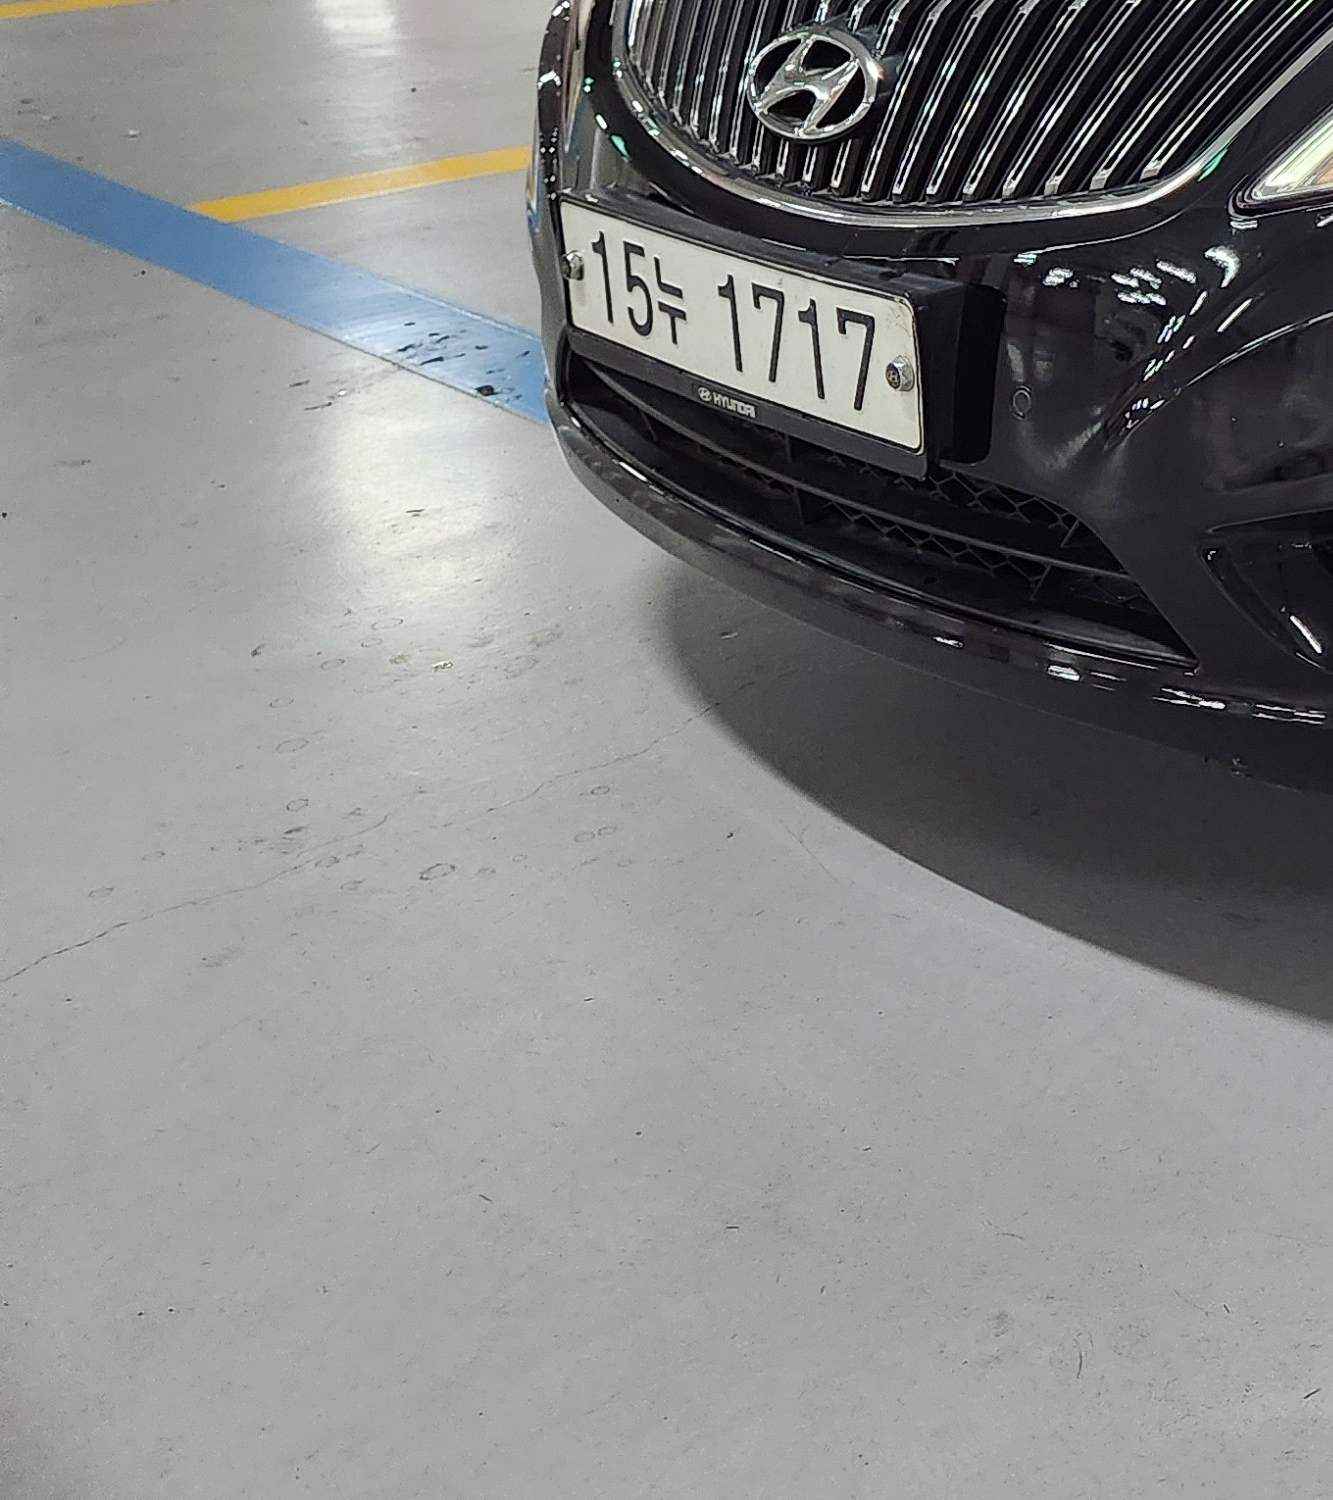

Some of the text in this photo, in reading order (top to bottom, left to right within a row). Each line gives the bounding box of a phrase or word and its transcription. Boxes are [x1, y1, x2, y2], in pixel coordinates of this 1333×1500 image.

[591, 230, 876, 411] 15누 1717
[712, 391, 756, 419] HYUNDAI
